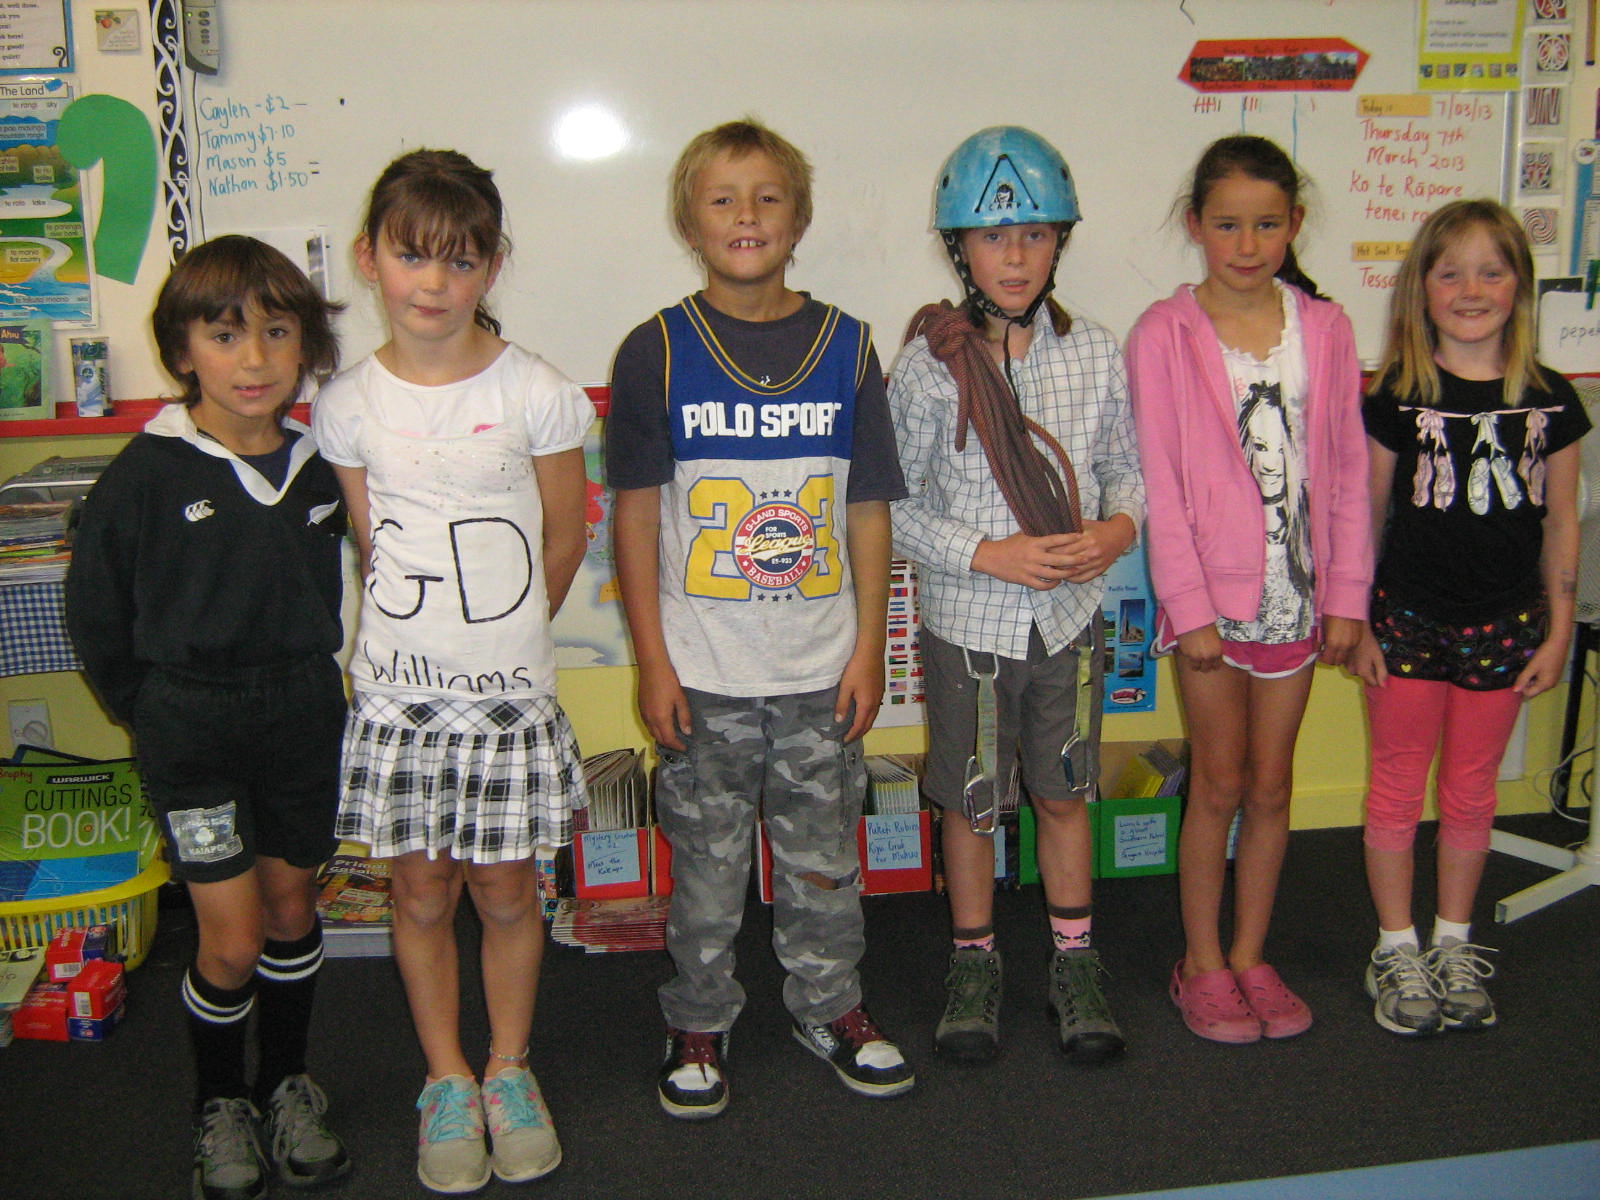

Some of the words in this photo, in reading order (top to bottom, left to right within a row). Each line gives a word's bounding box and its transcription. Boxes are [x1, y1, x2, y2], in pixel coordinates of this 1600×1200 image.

[1, 86, 18, 96] The
[20, 86, 44, 96] Land
[200, 128, 257, 153] Tammy
[1360, 119, 1430, 155] Thursday
[206, 154, 257, 172] Mason
[264, 146, 287, 167] $5
[1367, 146, 1418, 167] March
[1429, 153, 1466, 172] 2013
[208, 174, 258, 197] Nathan
[1377, 174, 1394, 197] te
[1559, 326, 1600, 348] pepe
[681, 401, 754, 439] POLO
[777, 508, 809, 532] SPORTS
[746, 566, 804, 586] BASEBALL
[52, 774, 111, 784] WARWICK
[24, 783, 133, 813] CUTTINGS
[22, 806, 132, 849] BOOK!
